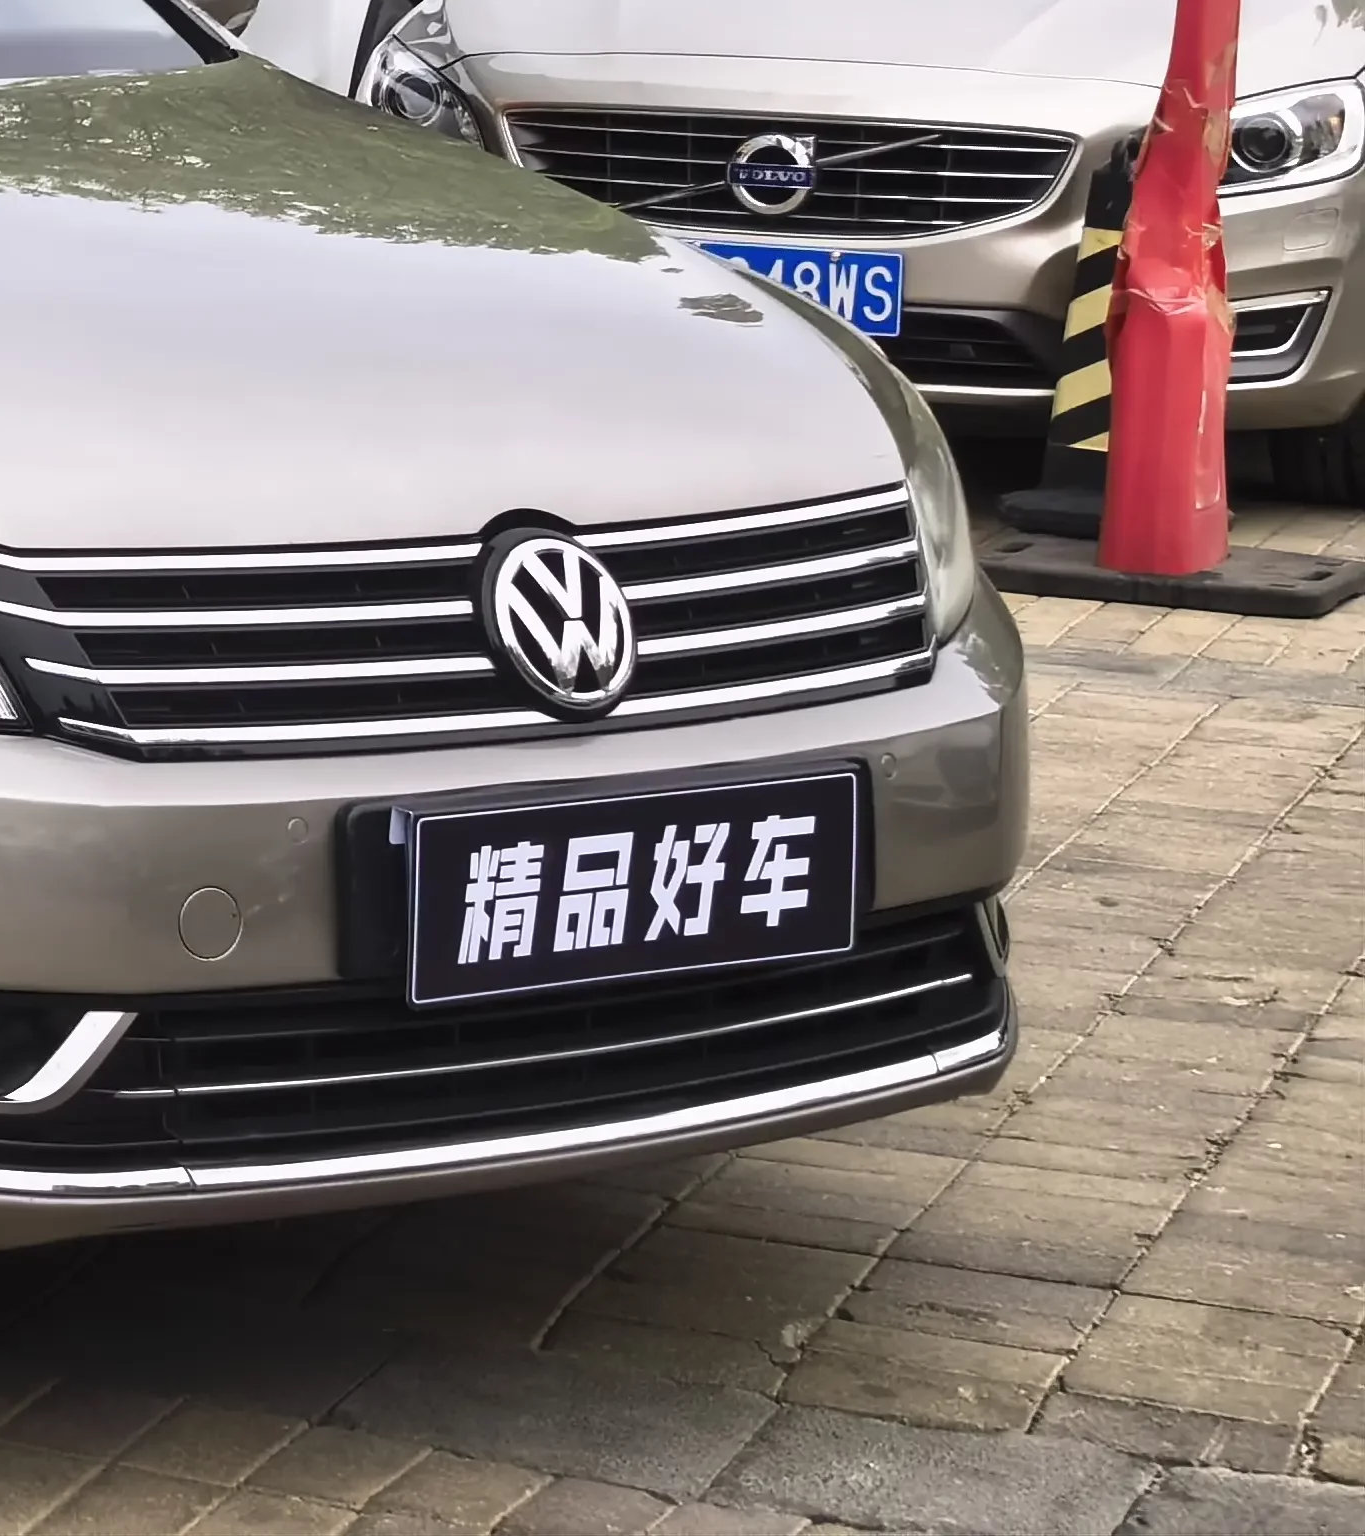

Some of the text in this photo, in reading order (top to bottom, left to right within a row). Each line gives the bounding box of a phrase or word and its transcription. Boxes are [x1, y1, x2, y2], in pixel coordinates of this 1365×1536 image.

[734, 166, 807, 183] VOLVO
[457, 814, 816, 965] 精品好车
